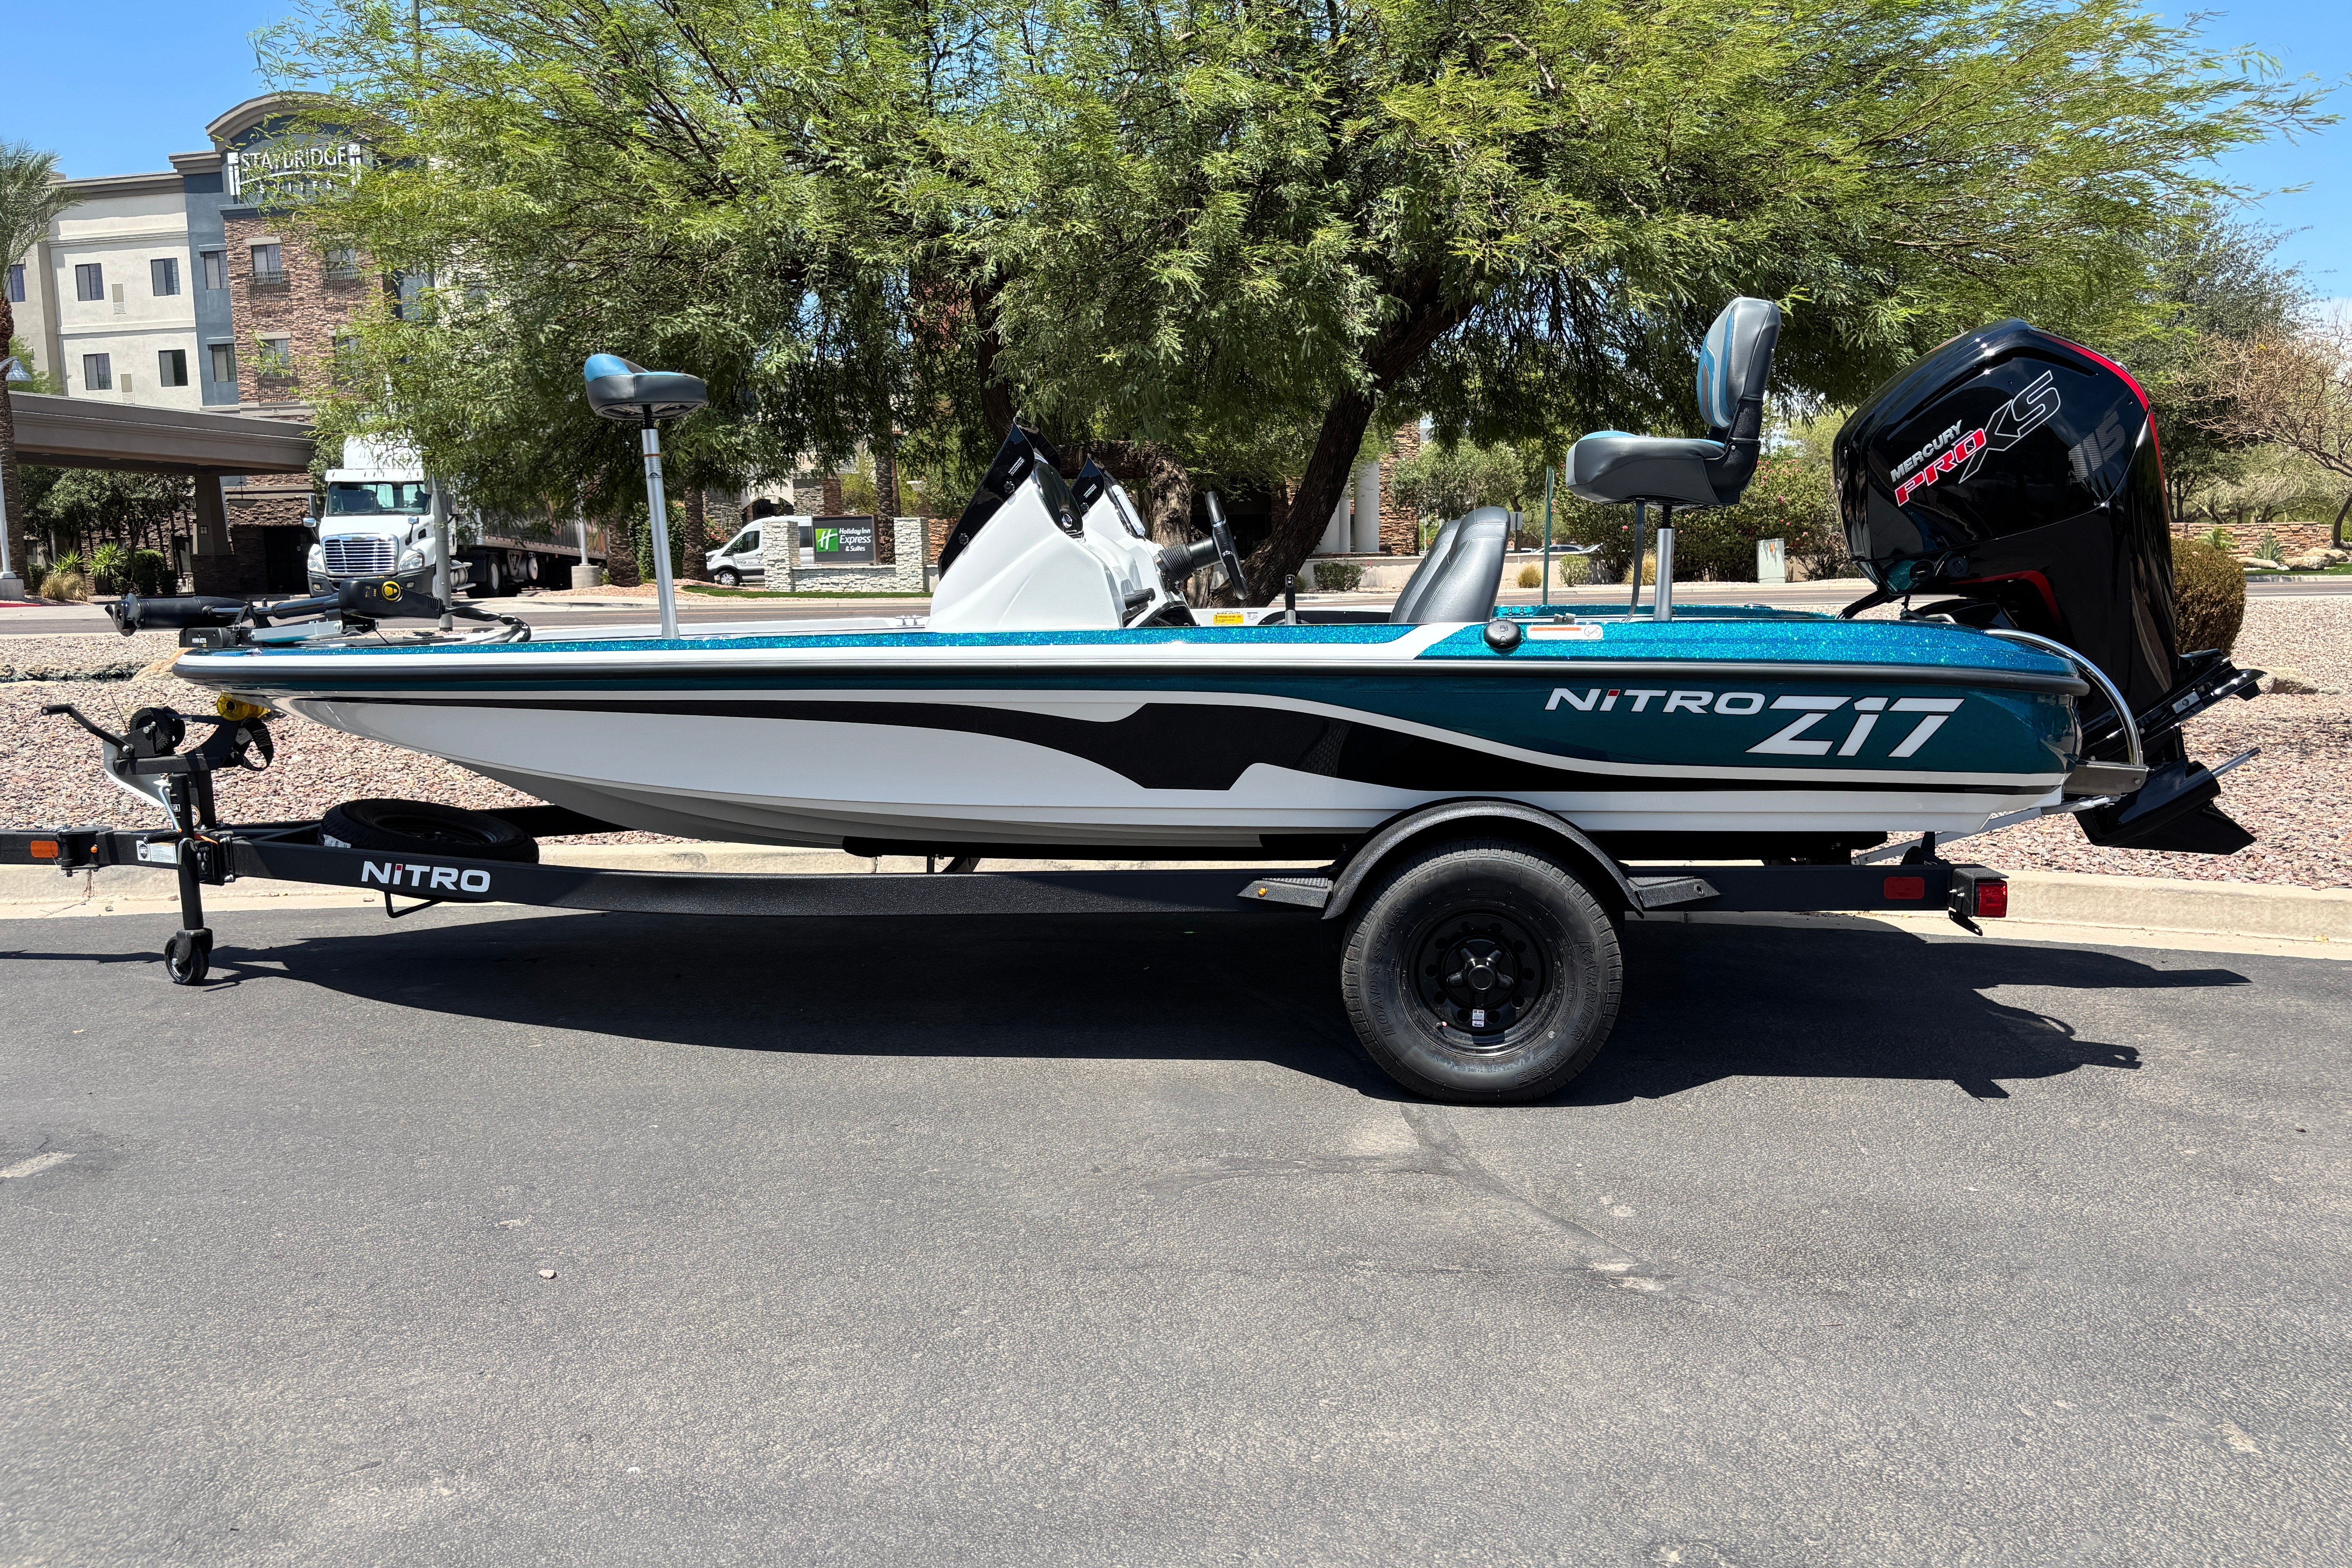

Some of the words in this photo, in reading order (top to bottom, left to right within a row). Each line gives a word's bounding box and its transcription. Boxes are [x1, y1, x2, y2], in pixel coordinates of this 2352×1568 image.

[240, 146, 346, 170] STABRIDGE
[1890, 419, 1962, 483] MERCURY
[1894, 427, 1987, 507] PRO
[839, 534, 871, 546] Express
[1544, 687, 1766, 716] NITRO
[1744, 695, 1966, 758] Z17
[361, 861, 491, 892] NITRO
[1373, 906, 1407, 961] STAR
[1369, 980, 1396, 1036] LOAD
[1569, 940, 1598, 1041] KARRIER
